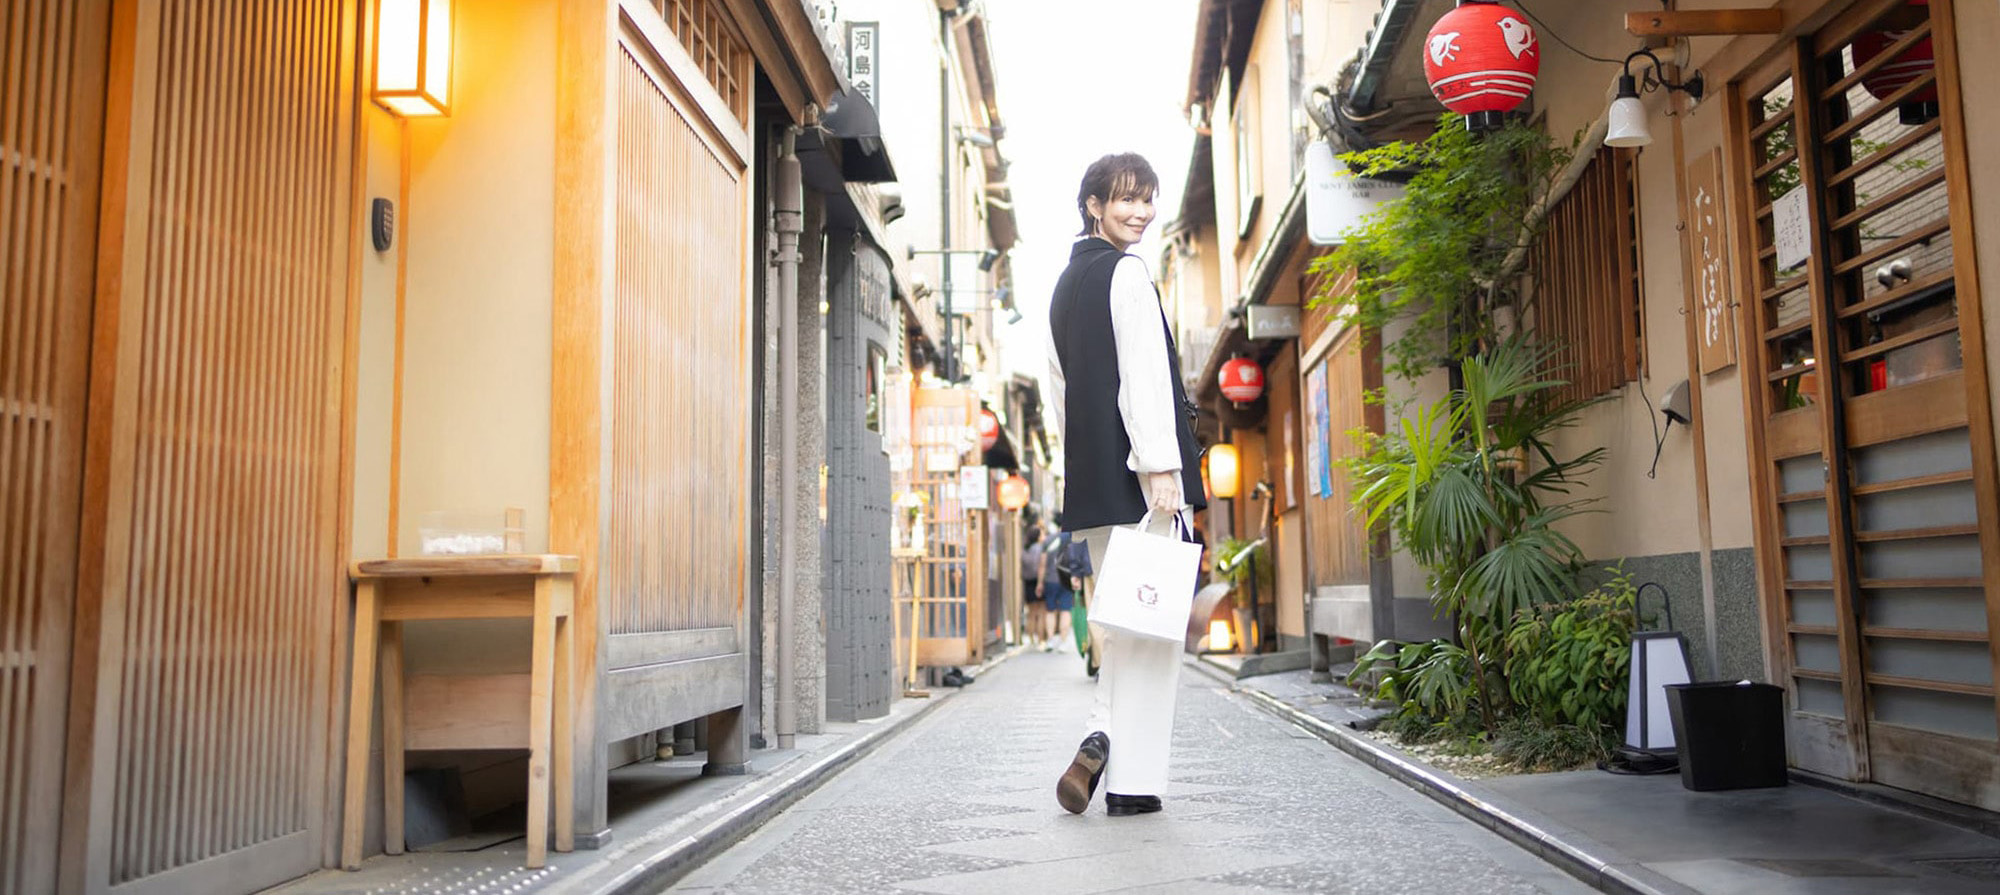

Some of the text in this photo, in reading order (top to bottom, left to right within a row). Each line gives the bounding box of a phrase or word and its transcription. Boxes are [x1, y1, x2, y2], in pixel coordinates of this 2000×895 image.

[1347, 181, 1377, 190] JAMES
[1352, 190, 1371, 199] BAR
[1695, 186, 1722, 348] たんぽぽ
